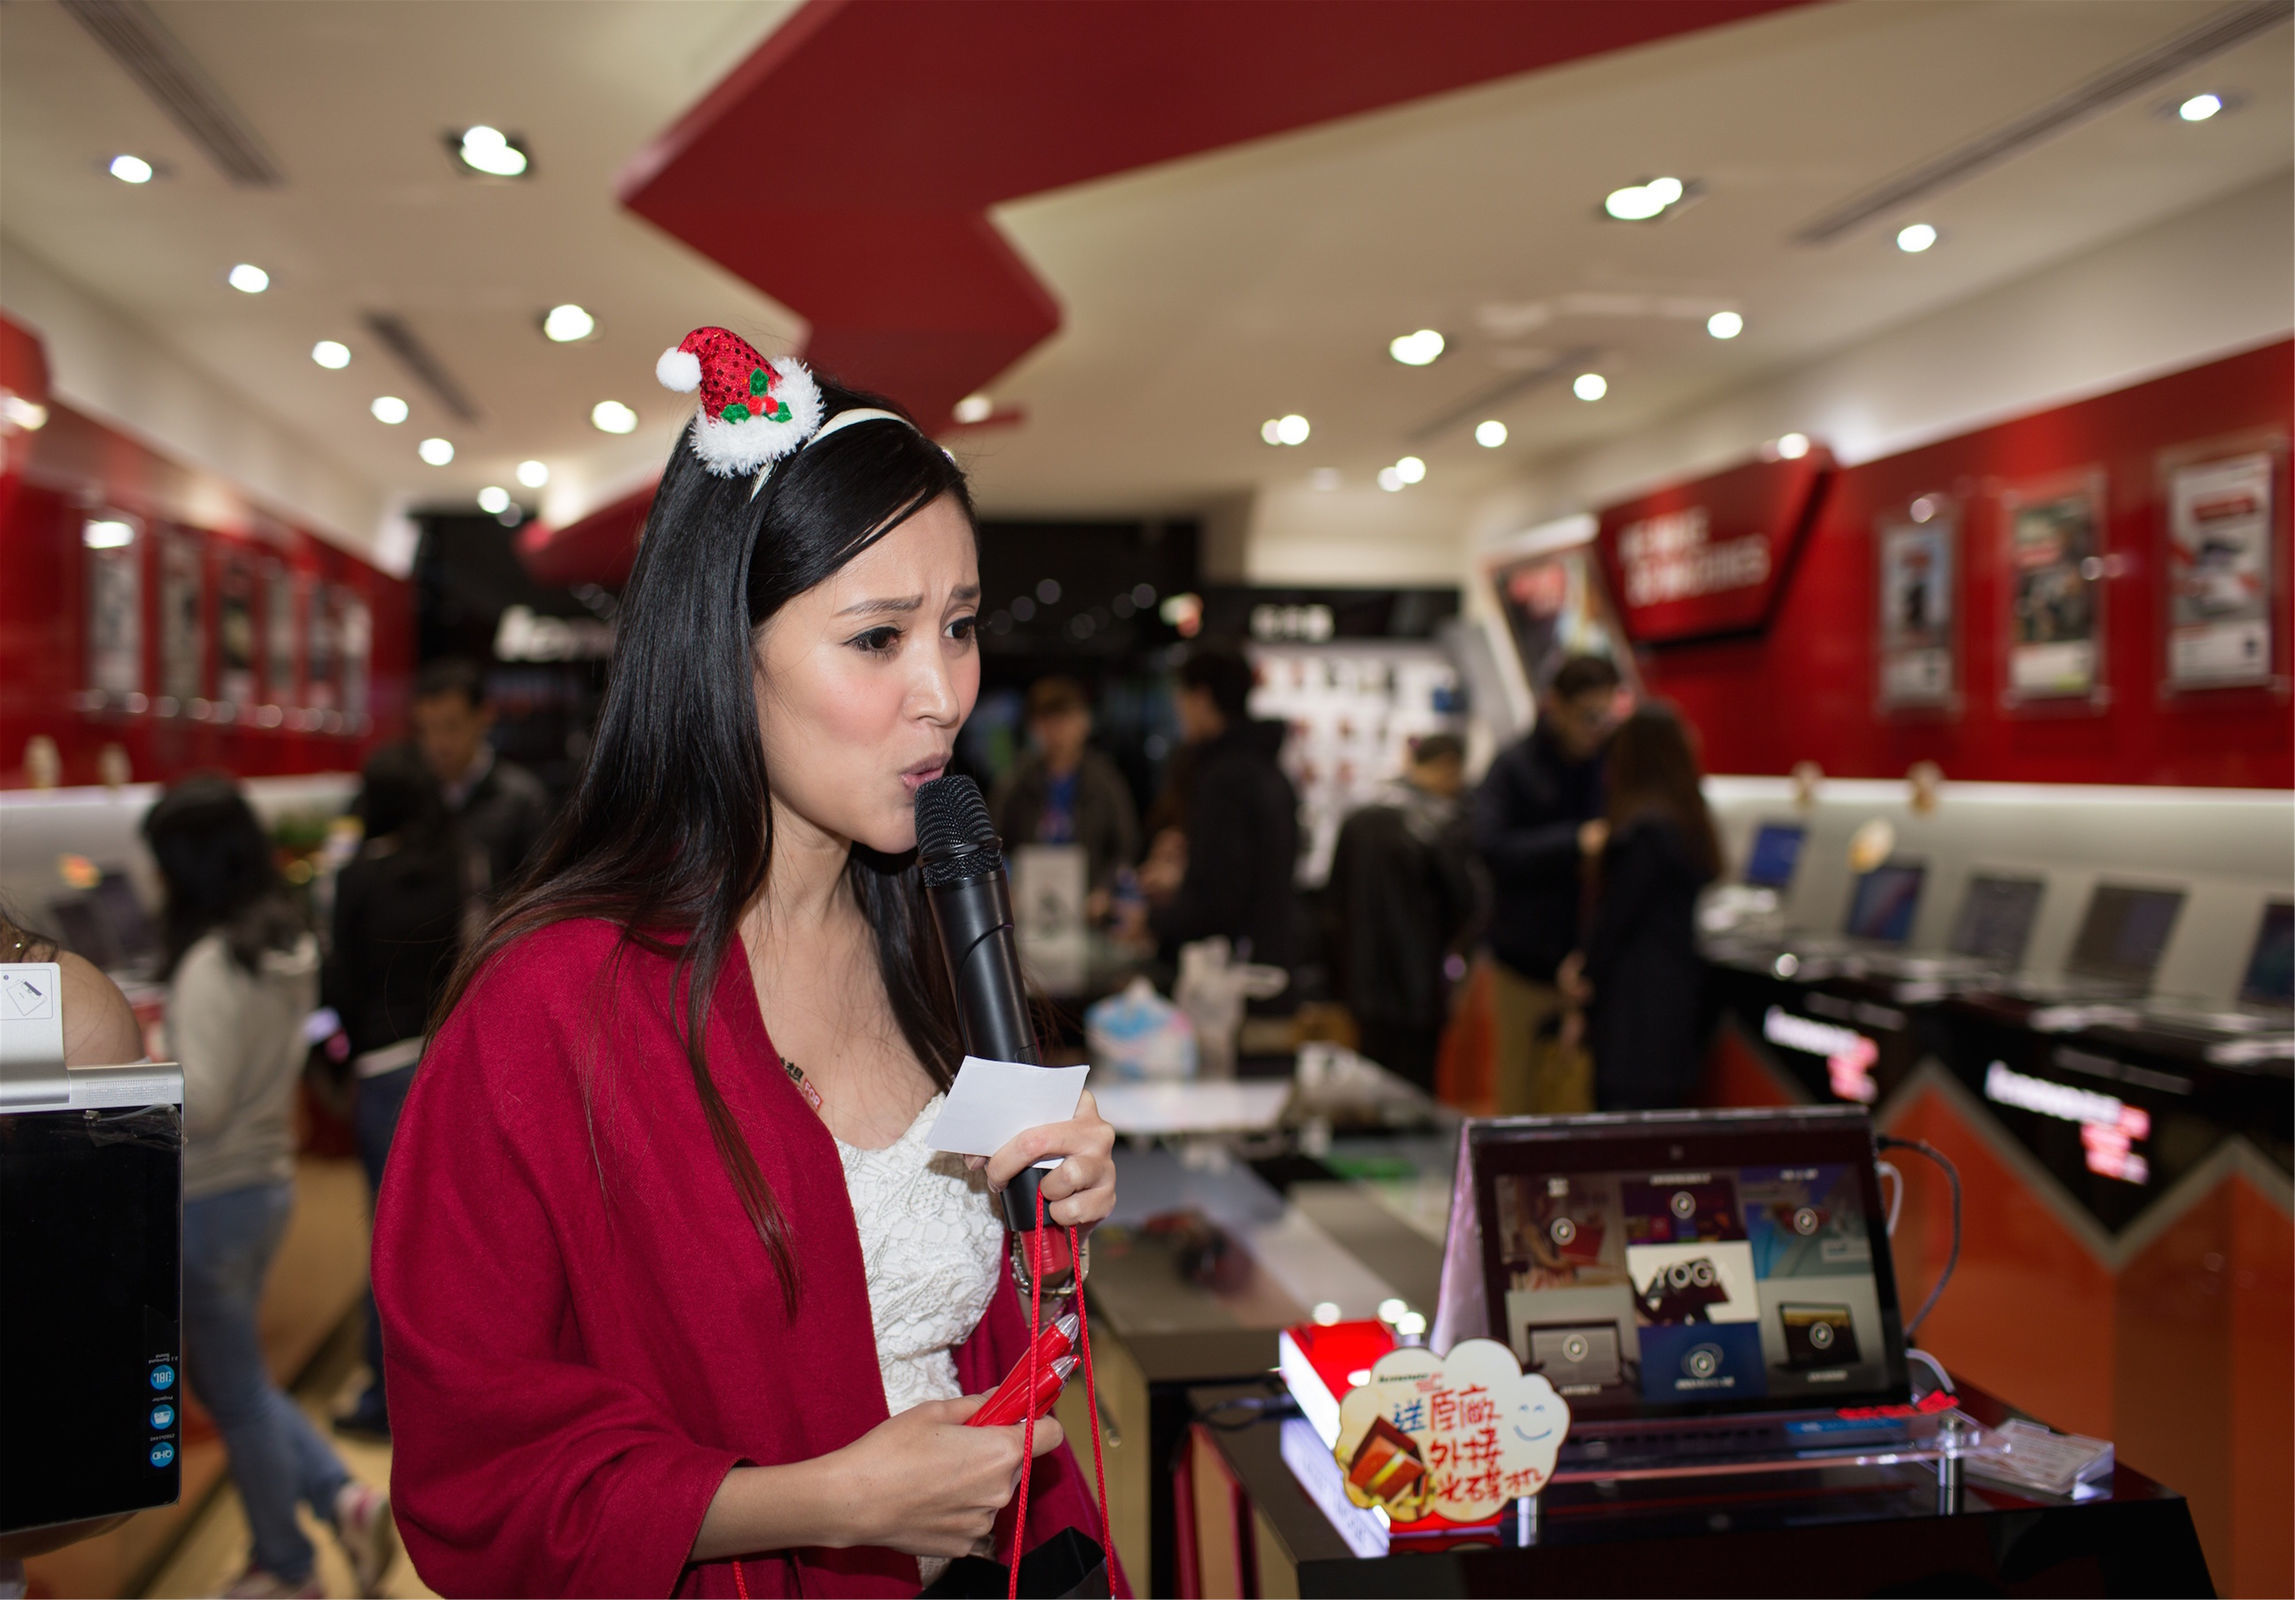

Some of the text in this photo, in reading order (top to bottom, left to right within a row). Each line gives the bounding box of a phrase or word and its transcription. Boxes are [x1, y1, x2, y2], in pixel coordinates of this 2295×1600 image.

[153, 1370, 172, 1384] JBL
[152, 1449, 172, 1460] QHD
[1430, 1428, 1503, 1471] 外接
